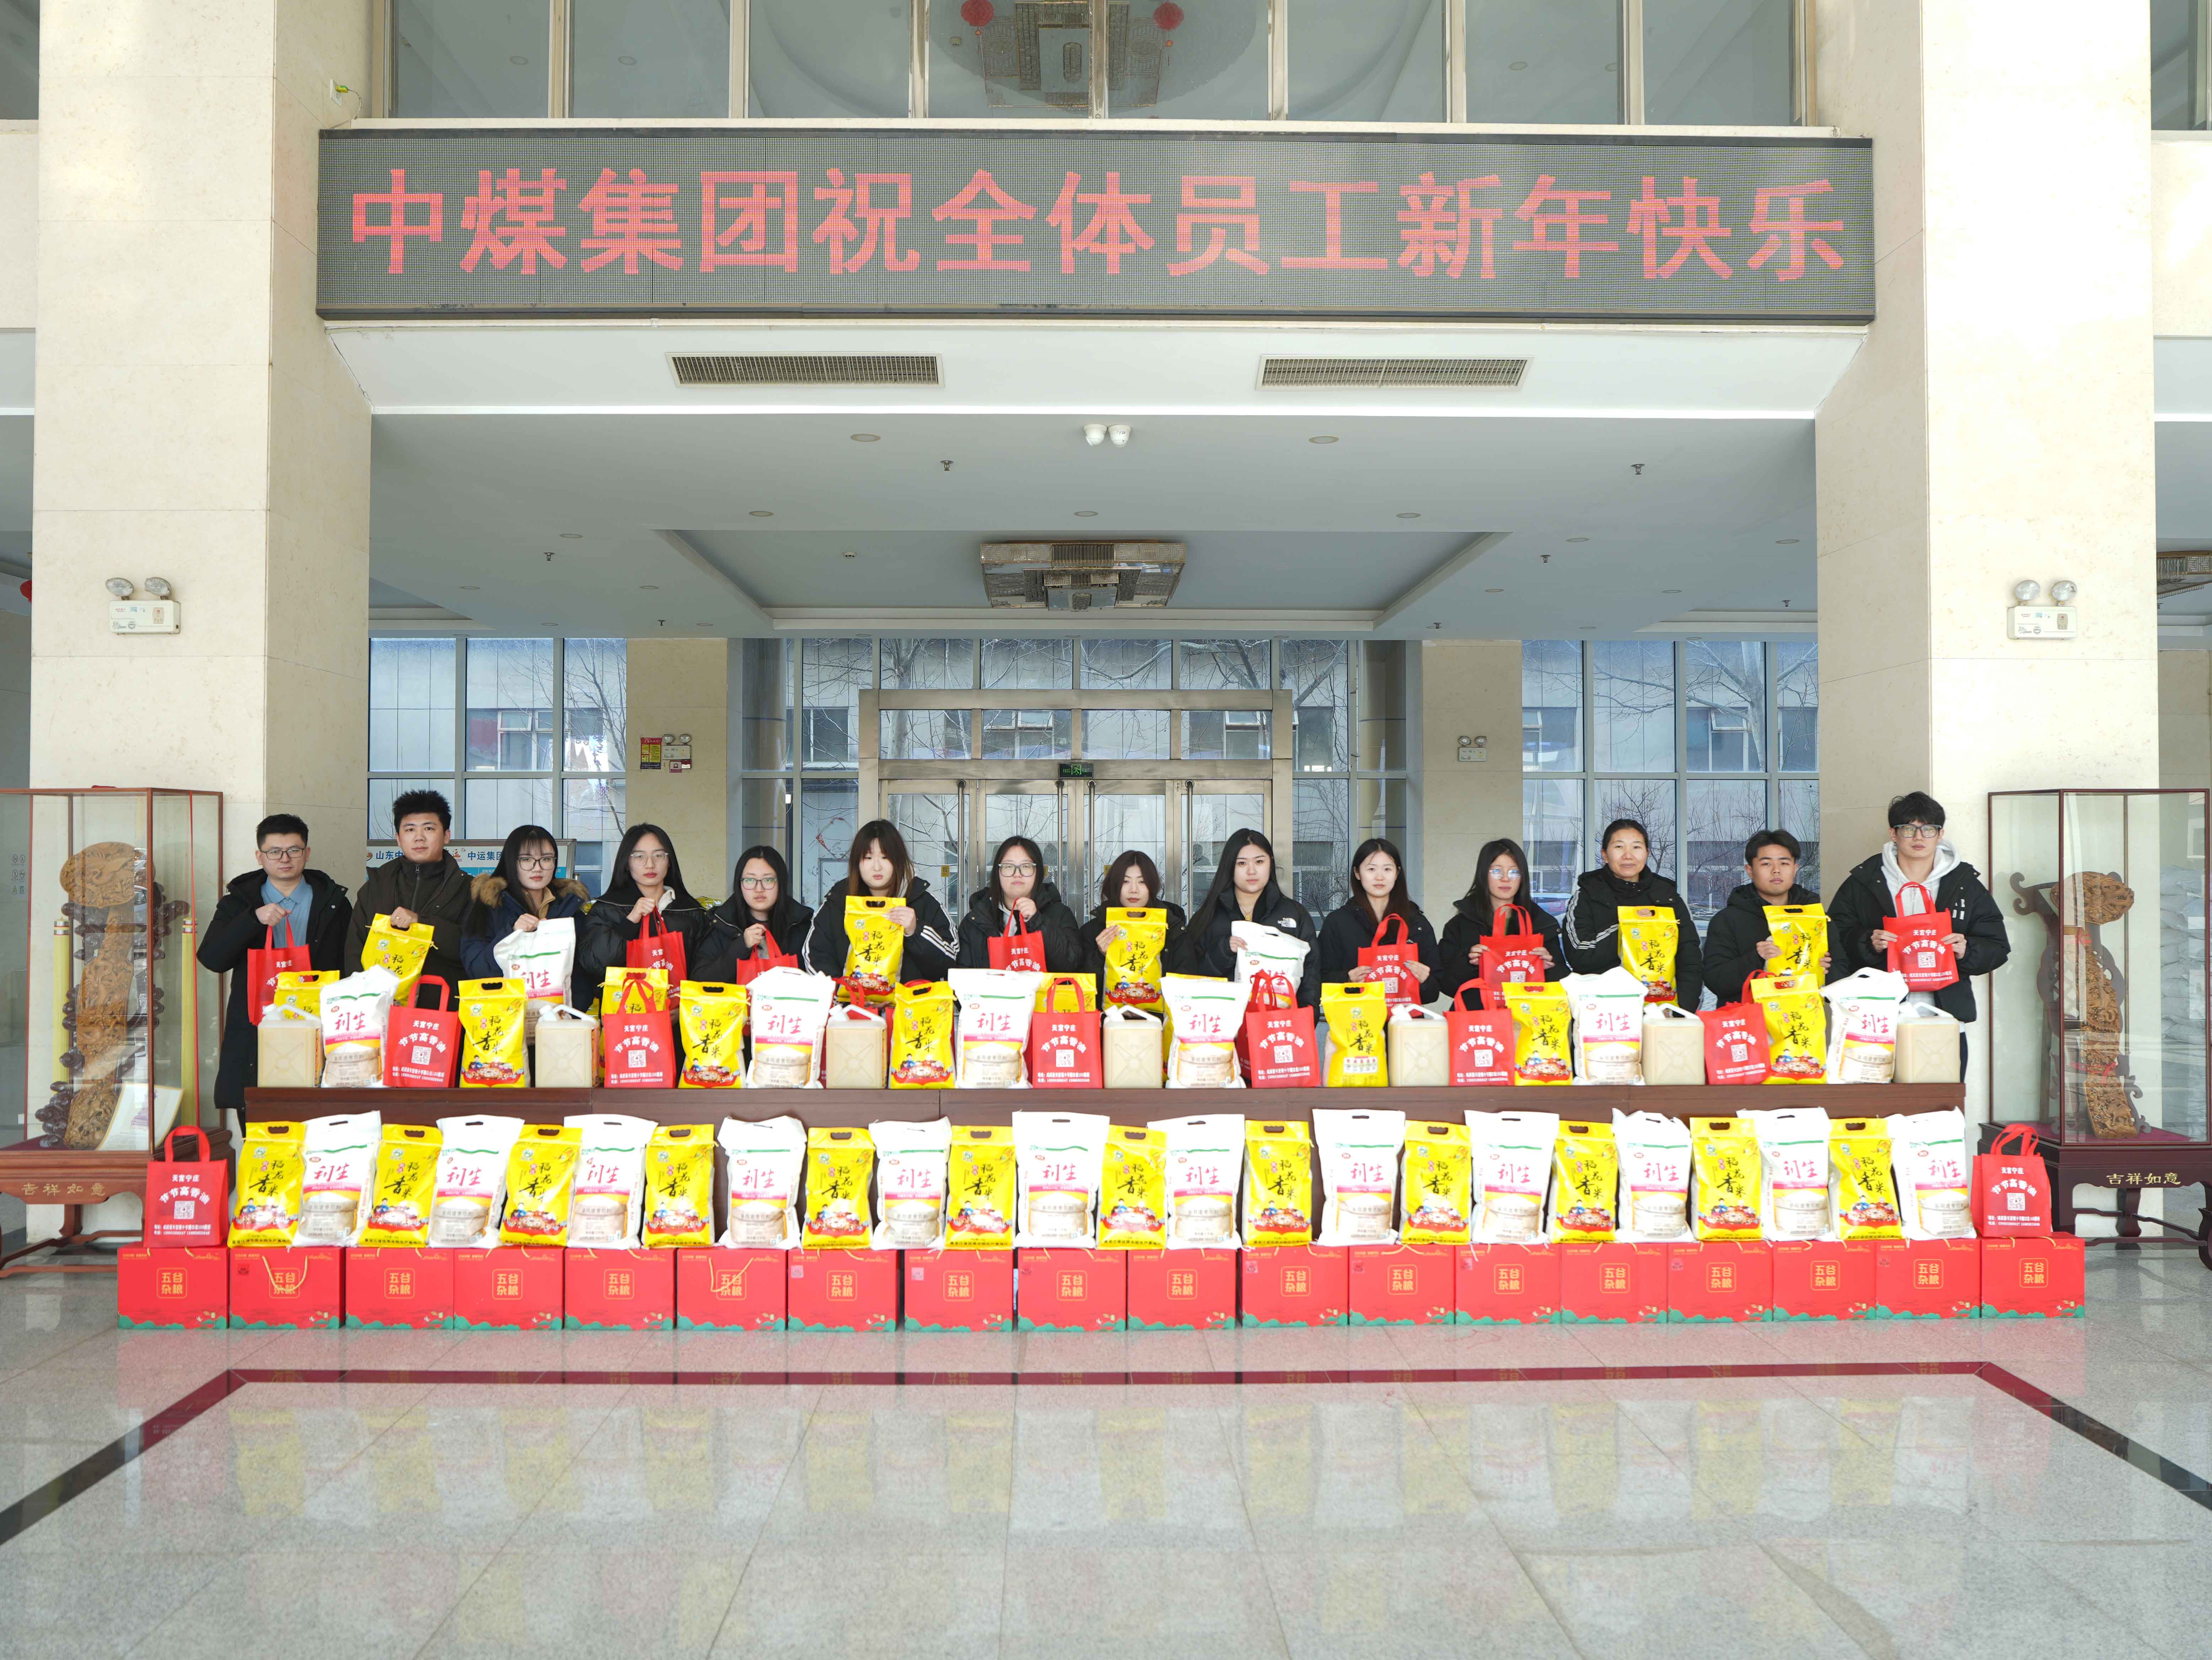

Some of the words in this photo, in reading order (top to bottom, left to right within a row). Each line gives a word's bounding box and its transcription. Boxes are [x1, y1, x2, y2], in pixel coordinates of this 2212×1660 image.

[351, 168, 1845, 281] 中煤集团祝全体员工新年快乐
[1903, 939, 1946, 954] 节节高香油
[1368, 965, 1408, 979] 节节高香油
[1497, 960, 1535, 974] 节节高香油
[335, 1012, 365, 1031] 利生
[769, 1015, 801, 1034] 利生
[978, 1013, 1010, 1031] 利生
[1191, 1014, 1220, 1033] 利生
[1597, 1013, 1630, 1031] 利生
[1863, 1015, 1888, 1034] 利生
[399, 1033, 446, 1053] 节节高香油
[614, 1036, 659, 1053] 节节高香油
[1041, 1035, 1086, 1053] 节节高香油
[1260, 1031, 1304, 1049] 节节高香油
[1459, 1036, 1504, 1052] 节节高香油
[1716, 1031, 1756, 1048] 节节高香油
[315, 1164, 349, 1182] 利生
[588, 1165, 619, 1184] 利生
[1044, 1165, 1075, 1181] 利生
[1352, 1163, 1384, 1182] 利生
[1499, 1164, 1530, 1183] 利生
[1645, 1163, 1678, 1181] 利生
[1785, 1160, 1818, 1179] 利生
[1930, 1161, 1961, 1178] 利生
[448, 1166, 481, 1186] 利生
[744, 1169, 773, 1189] 利生
[898, 1169, 930, 1188] 利生
[1186, 1167, 1219, 1185] 利生
[2106, 1172, 2181, 1185] 吉祥如意
[21, 1182, 106, 1197] 吉祥如意
[1991, 1179, 2036, 1196] 节节高香油
[160, 1186, 209, 1204] 节节高香油
[1499, 1268, 1520, 1279] 五谷
[1605, 1268, 1626, 1278] 五谷
[1712, 1267, 1732, 1278] 五谷
[1816, 1265, 1836, 1276] 五谷
[1919, 1263, 1939, 1274] 五谷
[2024, 1262, 2044, 1273] 五谷
[163, 1273, 183, 1283] 五谷
[274, 1273, 295, 1283] 五谷
[391, 1273, 411, 1284] 五谷
[498, 1273, 518, 1284] 五谷
[609, 1273, 629, 1284] 五谷
[722, 1274, 742, 1285] 五谷
[1063, 1275, 1083, 1285] 五谷
[1173, 1274, 1193, 1284] 五谷
[1286, 1270, 1306, 1282] 五谷
[1393, 1269, 1413, 1279] 五谷
[1918, 1274, 1939, 1284] 杂粮
[2024, 1273, 2044, 1283] 杂粮
[833, 1275, 853, 1286] 五谷
[949, 1275, 969, 1287] 五谷
[1393, 1280, 1414, 1290] 杂粮
[1499, 1279, 1520, 1290] 杂粮
[1605, 1278, 1626, 1289] 杂粮
[1712, 1278, 1732, 1288] 杂粮
[1815, 1276, 1837, 1286] 杂粮
[162, 1283, 183, 1294] 杂粮
[274, 1284, 295, 1294] 杂粮
[390, 1284, 411, 1294] 杂粮
[497, 1284, 518, 1295] 杂粮
[608, 1284, 630, 1295] 杂粮
[719, 1285, 742, 1296] 杂粮
[832, 1286, 853, 1296] 杂粮
[949, 1287, 969, 1297] 杂粮
[1062, 1285, 1083, 1297] 杂粮
[1172, 1284, 1193, 1295] 杂粮
[1285, 1282, 1307, 1292] 杂粮
